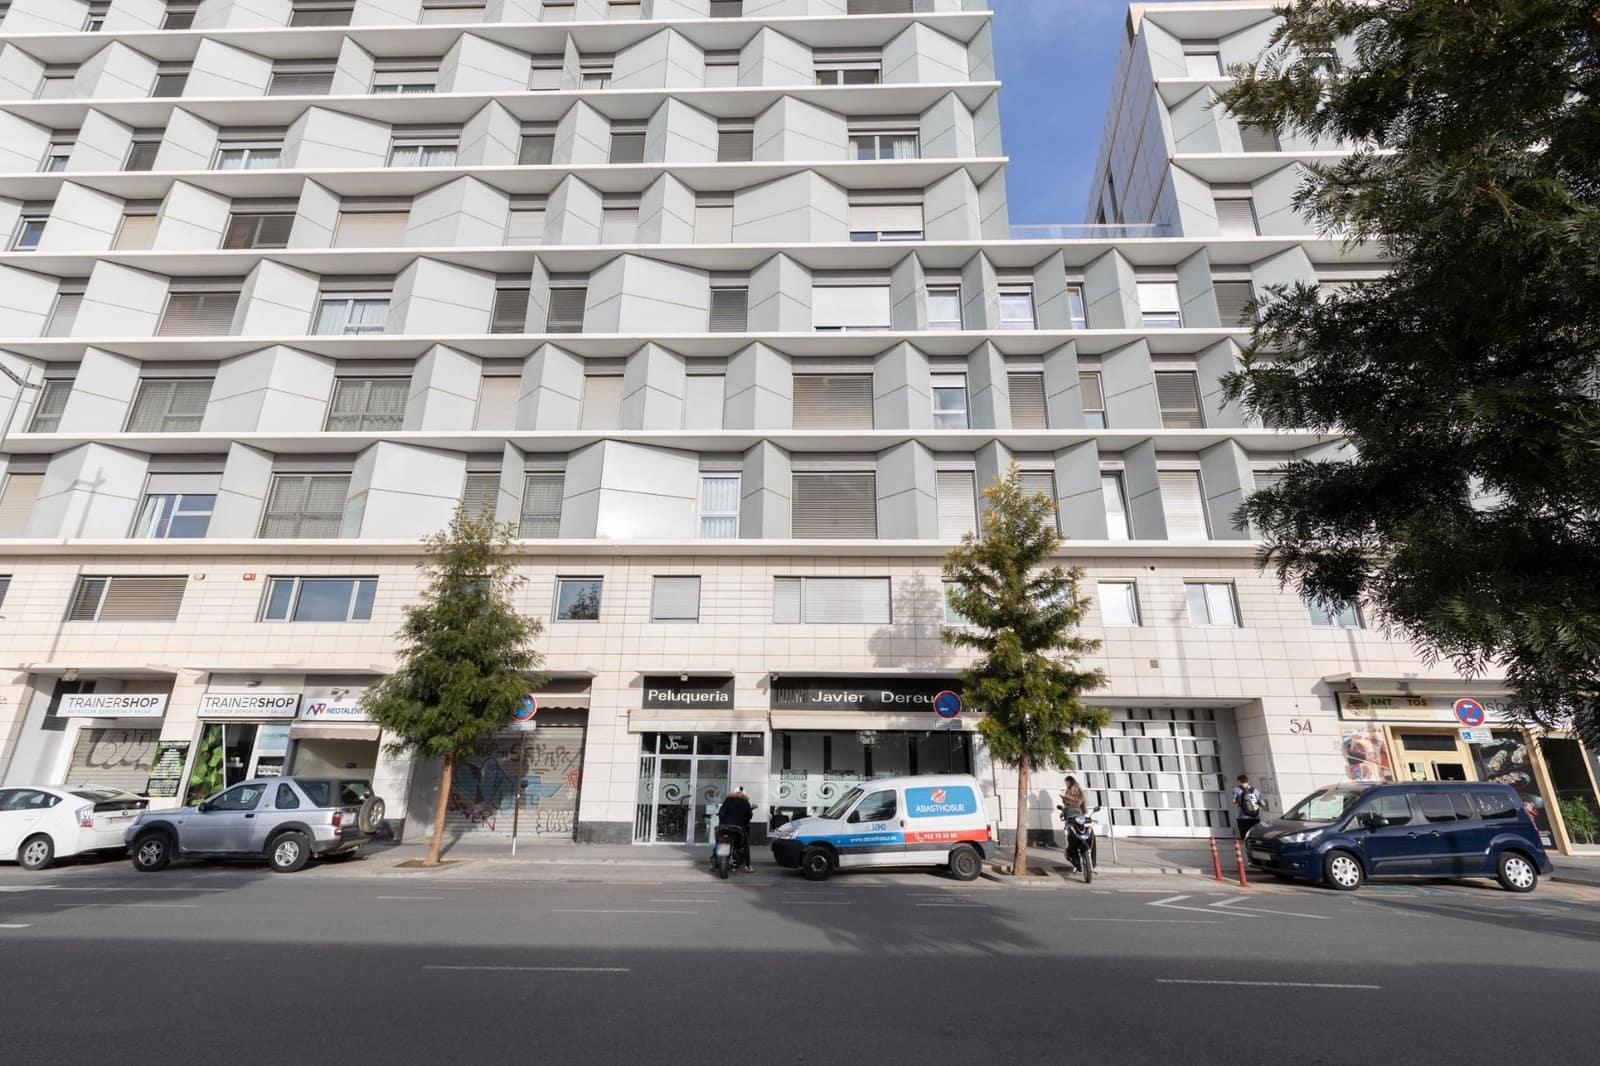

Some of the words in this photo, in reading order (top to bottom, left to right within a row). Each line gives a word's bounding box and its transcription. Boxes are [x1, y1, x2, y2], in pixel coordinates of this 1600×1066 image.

[68, 697, 159, 708] TRAINERSHOP
[204, 697, 294, 708] TRAINERSHOP
[648, 690, 728, 704] Peluqueria
[812, 691, 865, 703] Javier
[1290, 718, 1312, 733] 54
[915, 803, 965, 813] ABASTHOSUR
